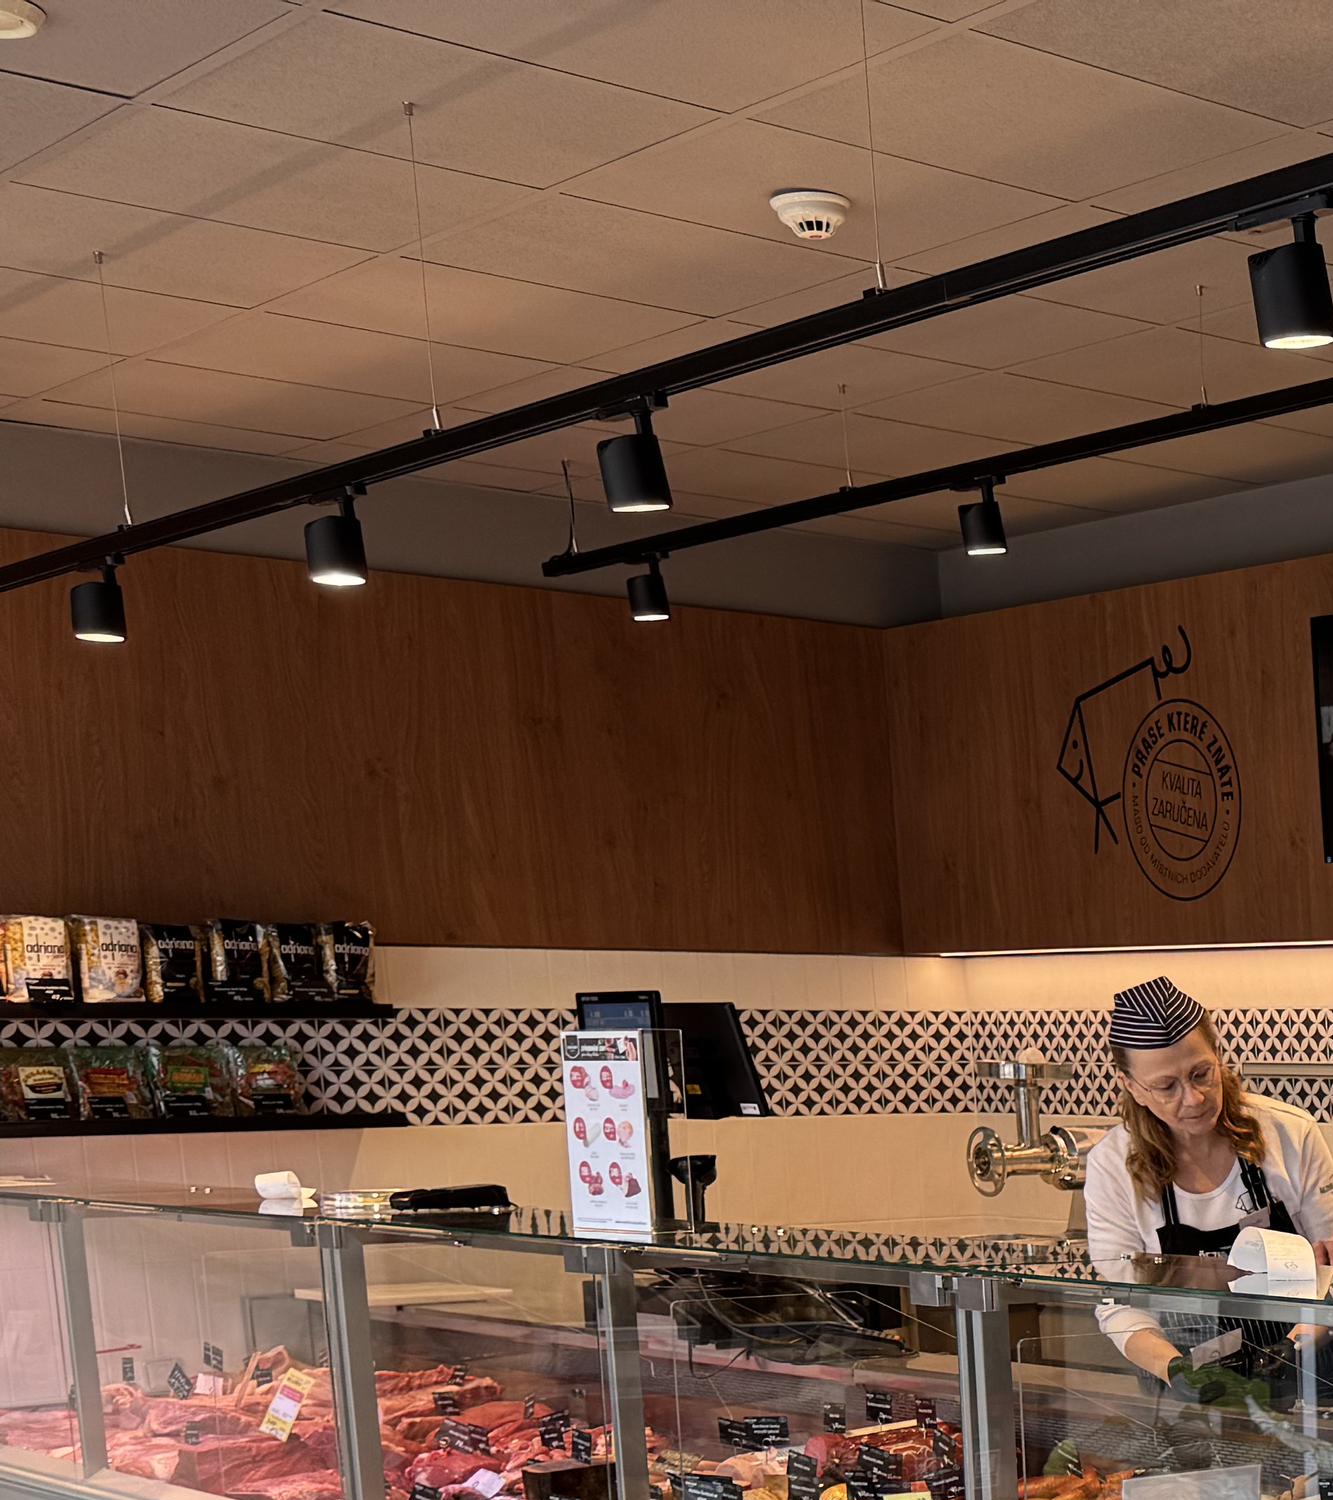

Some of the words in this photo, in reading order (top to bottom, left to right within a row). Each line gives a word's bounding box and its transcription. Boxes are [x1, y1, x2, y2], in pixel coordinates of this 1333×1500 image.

[1132, 718, 1165, 779] PRASE
[1167, 711, 1209, 742] KTERÉ
[1206, 733, 1234, 802] ZNÁTE
[1161, 770, 1203, 800] KVALITA
[1151, 796, 1209, 832] ZARUČENA
